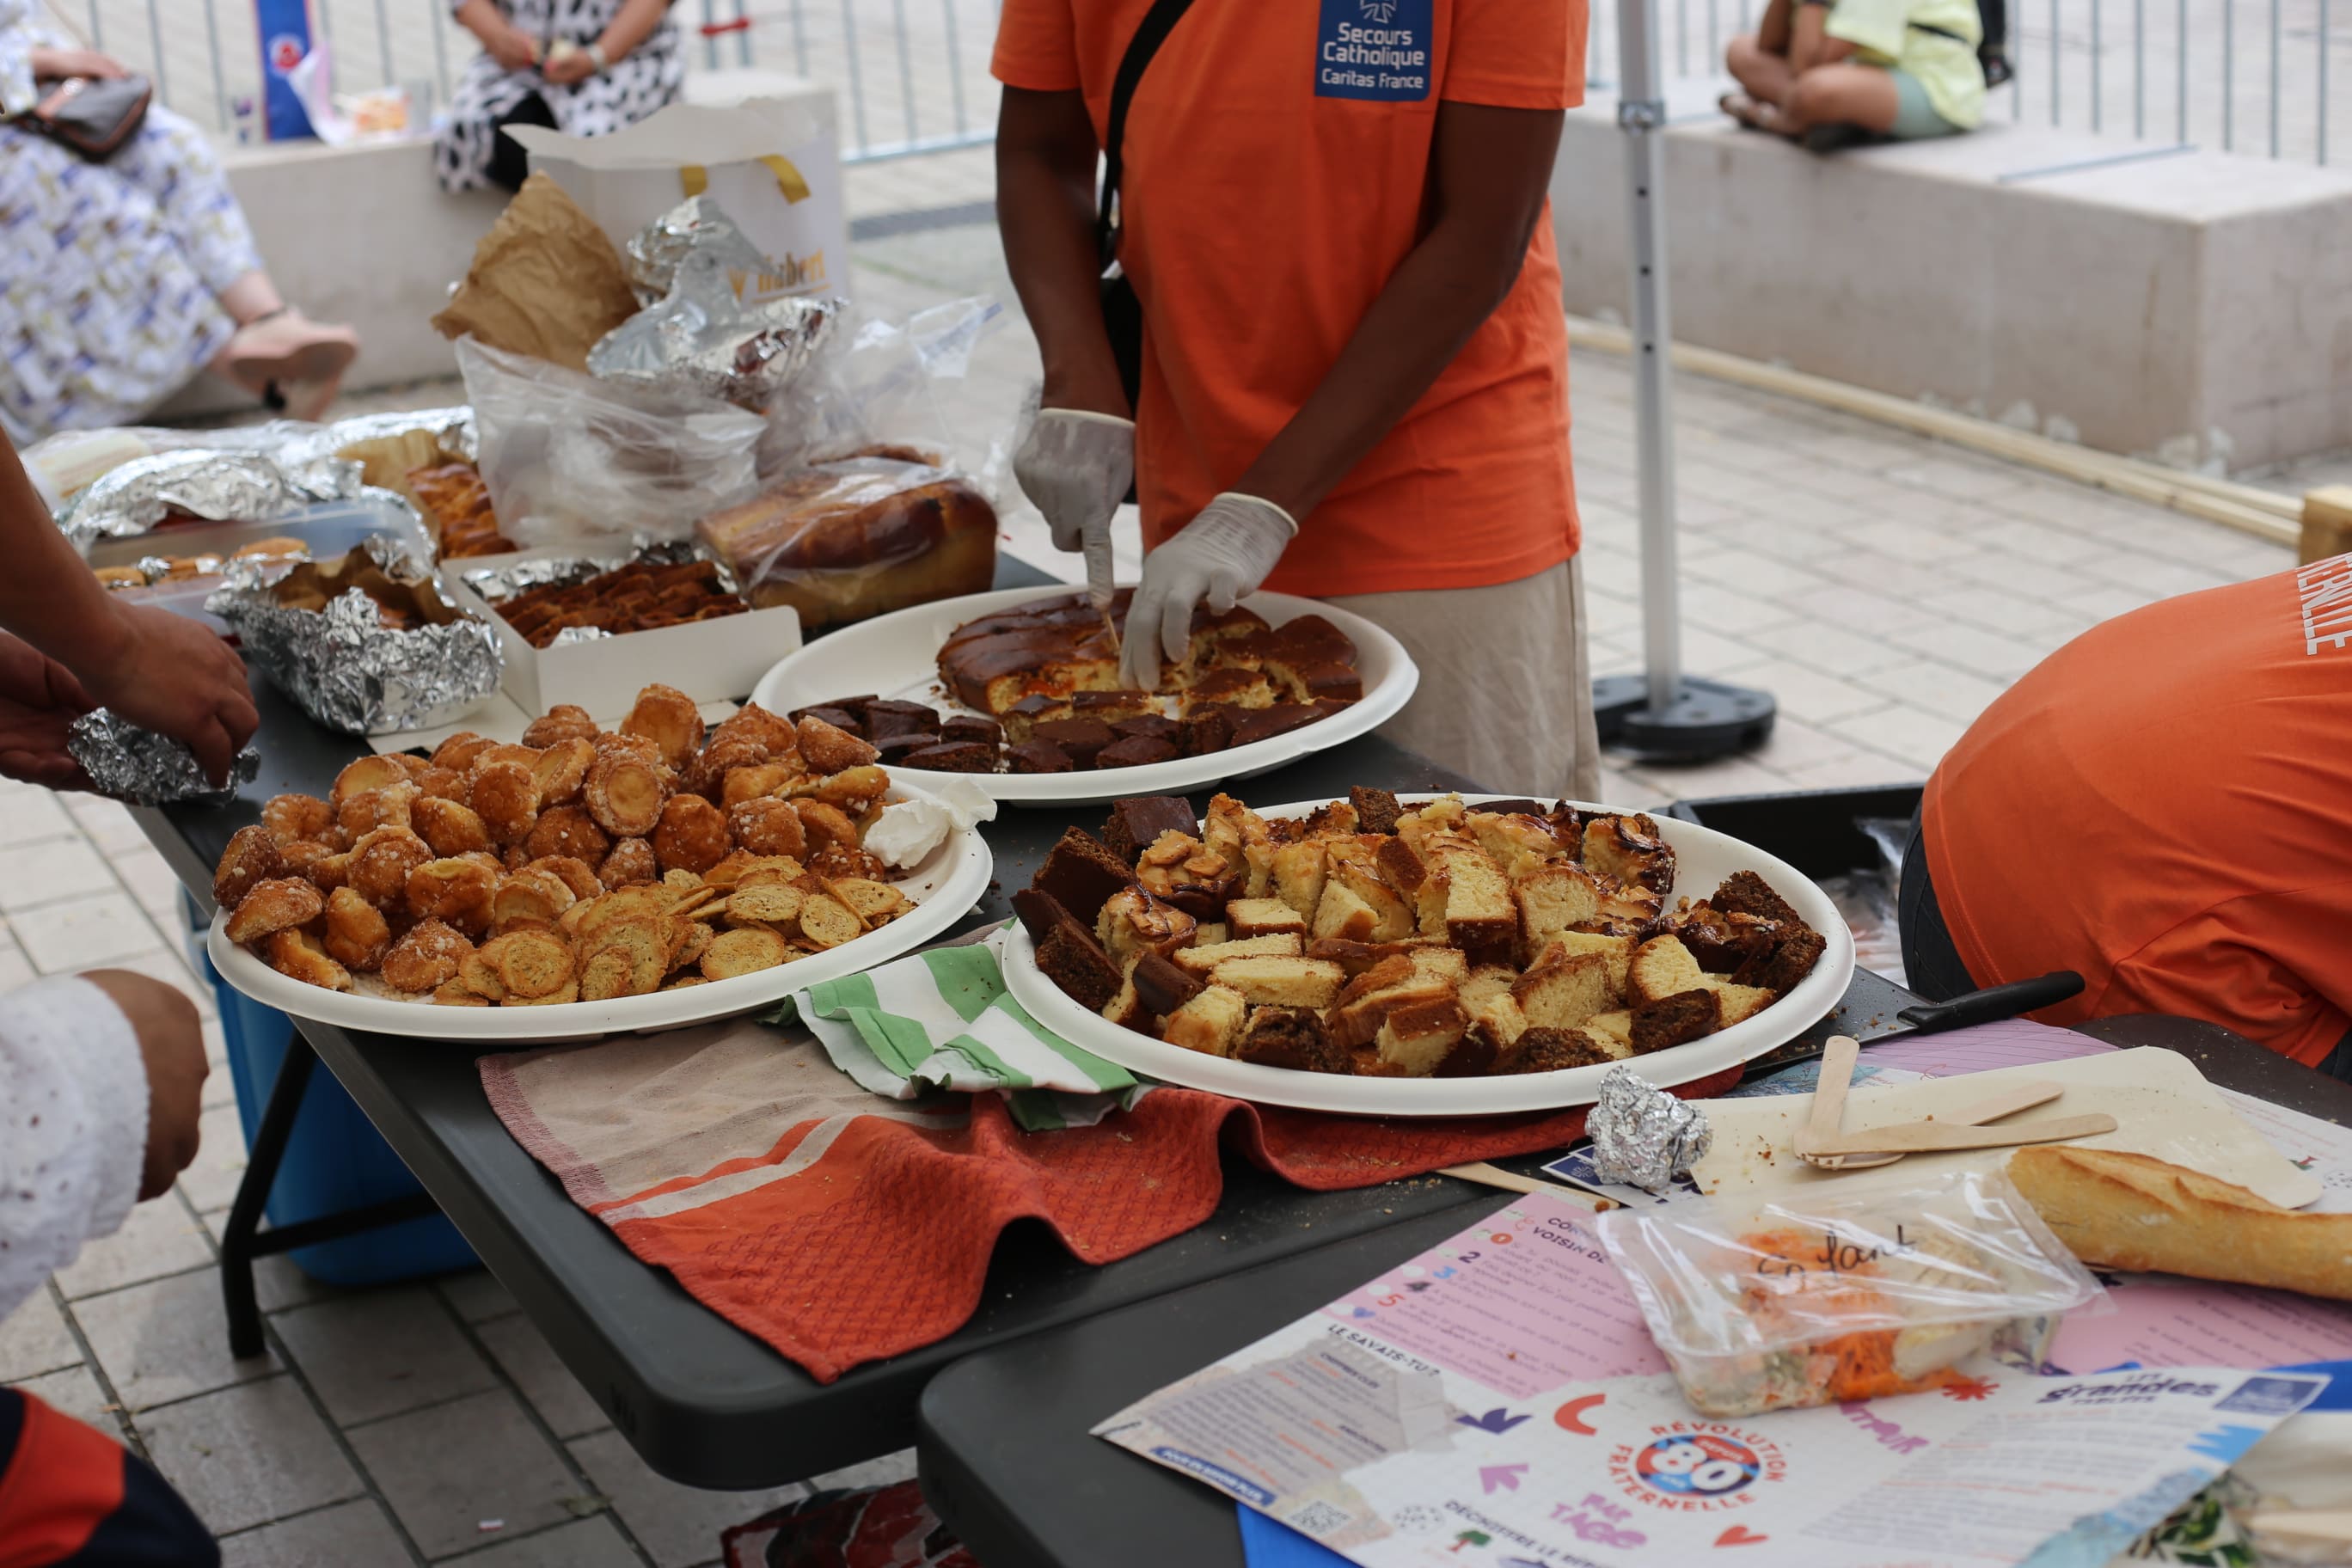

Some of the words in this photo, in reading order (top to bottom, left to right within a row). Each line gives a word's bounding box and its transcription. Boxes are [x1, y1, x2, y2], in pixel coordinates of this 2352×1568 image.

[1337, 21, 1412, 46] Secours
[1323, 41, 1425, 70] Catholique
[1321, 67, 1375, 88] Caritas
[1378, 72, 1424, 89] France
[1533, 1226, 1588, 1254] VOISIN
[1458, 1251, 1481, 1264] 2
[1432, 1265, 1458, 1279] 3
[1377, 1294, 1406, 1307] 5
[1328, 1324, 1348, 1336] LE
[2036, 1378, 2220, 1405] grandes
[1649, 1420, 1787, 1483] RÉVOLUTION
[1608, 1444, 1756, 1512] FRATERNELLE
[1650, 1442, 1745, 1491] 80
